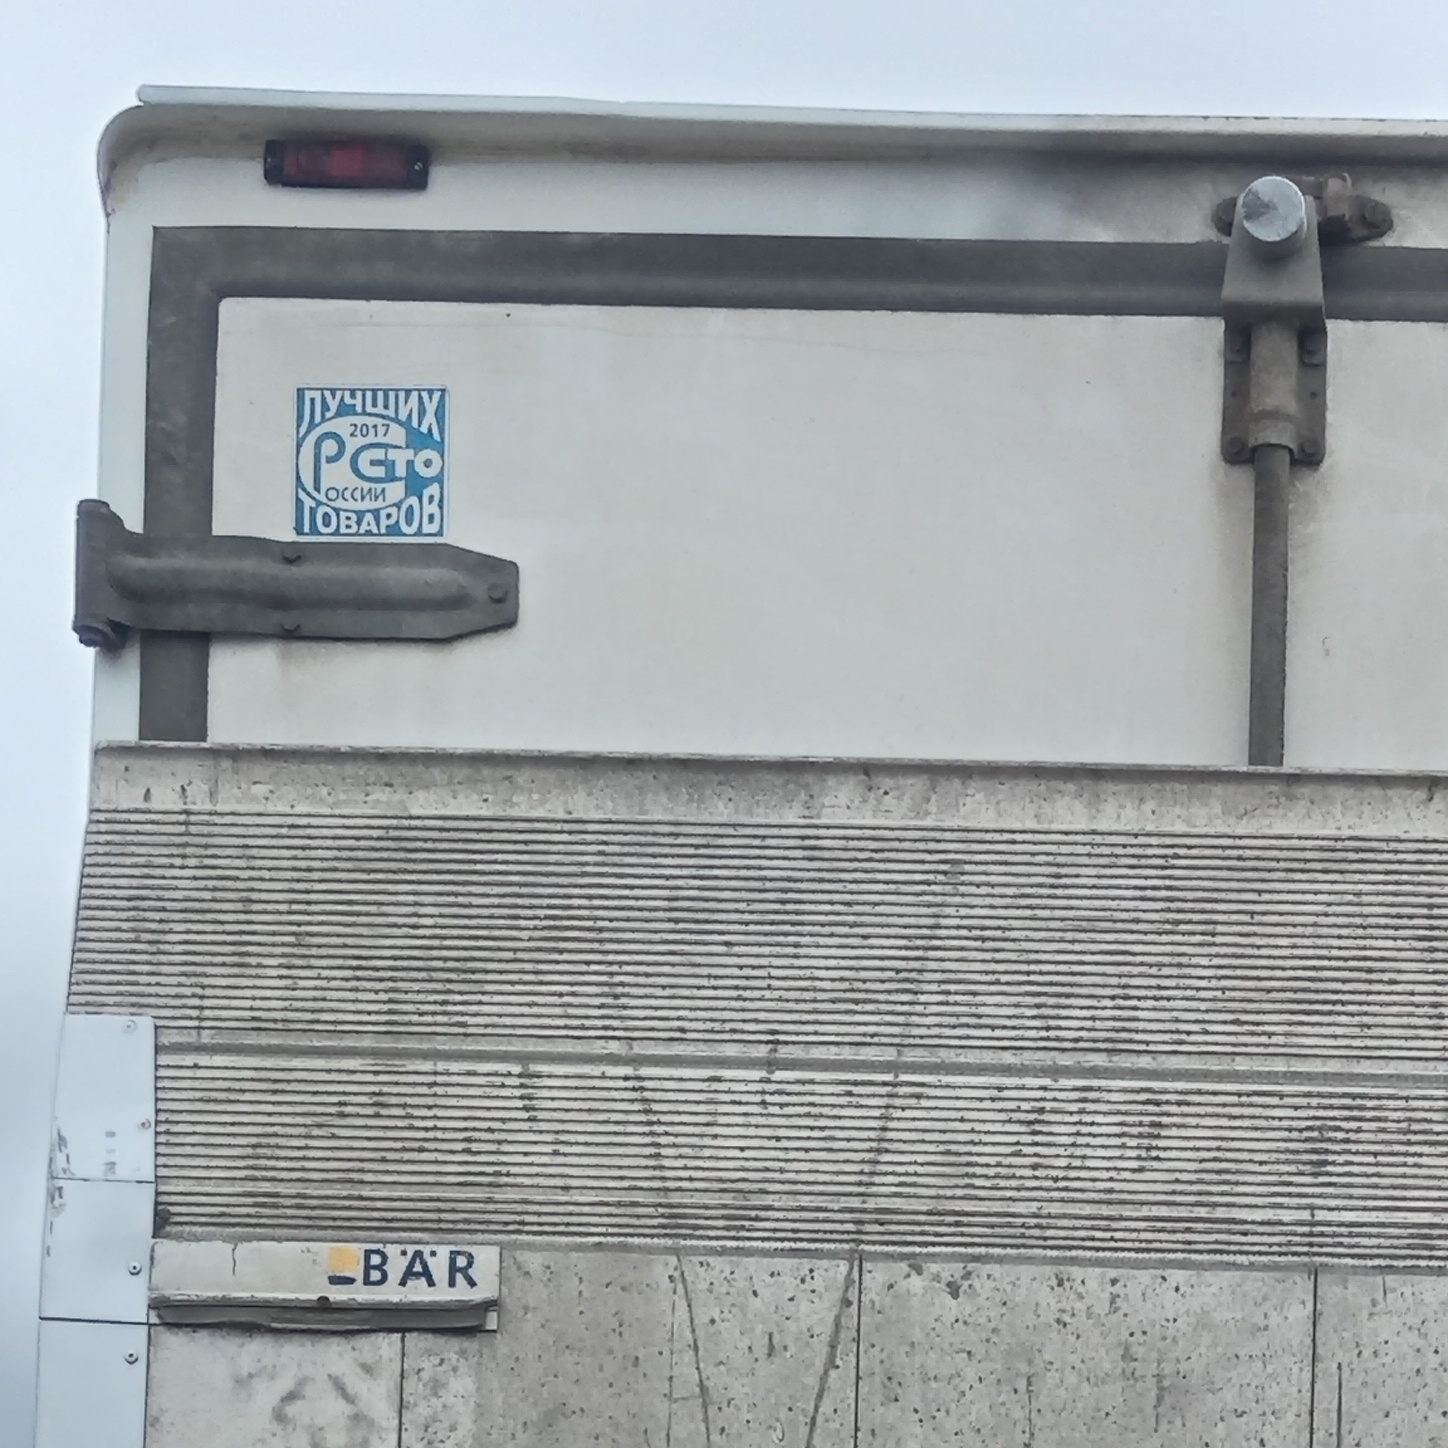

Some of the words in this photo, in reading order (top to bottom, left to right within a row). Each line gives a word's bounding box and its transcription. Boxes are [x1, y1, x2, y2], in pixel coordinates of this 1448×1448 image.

[298, 389, 443, 443] ЛУЧШИХ
[349, 423, 391, 438] 2017
[297, 483, 443, 535] ТОВАРОВ
[362, 1248, 478, 1289] BÄR
